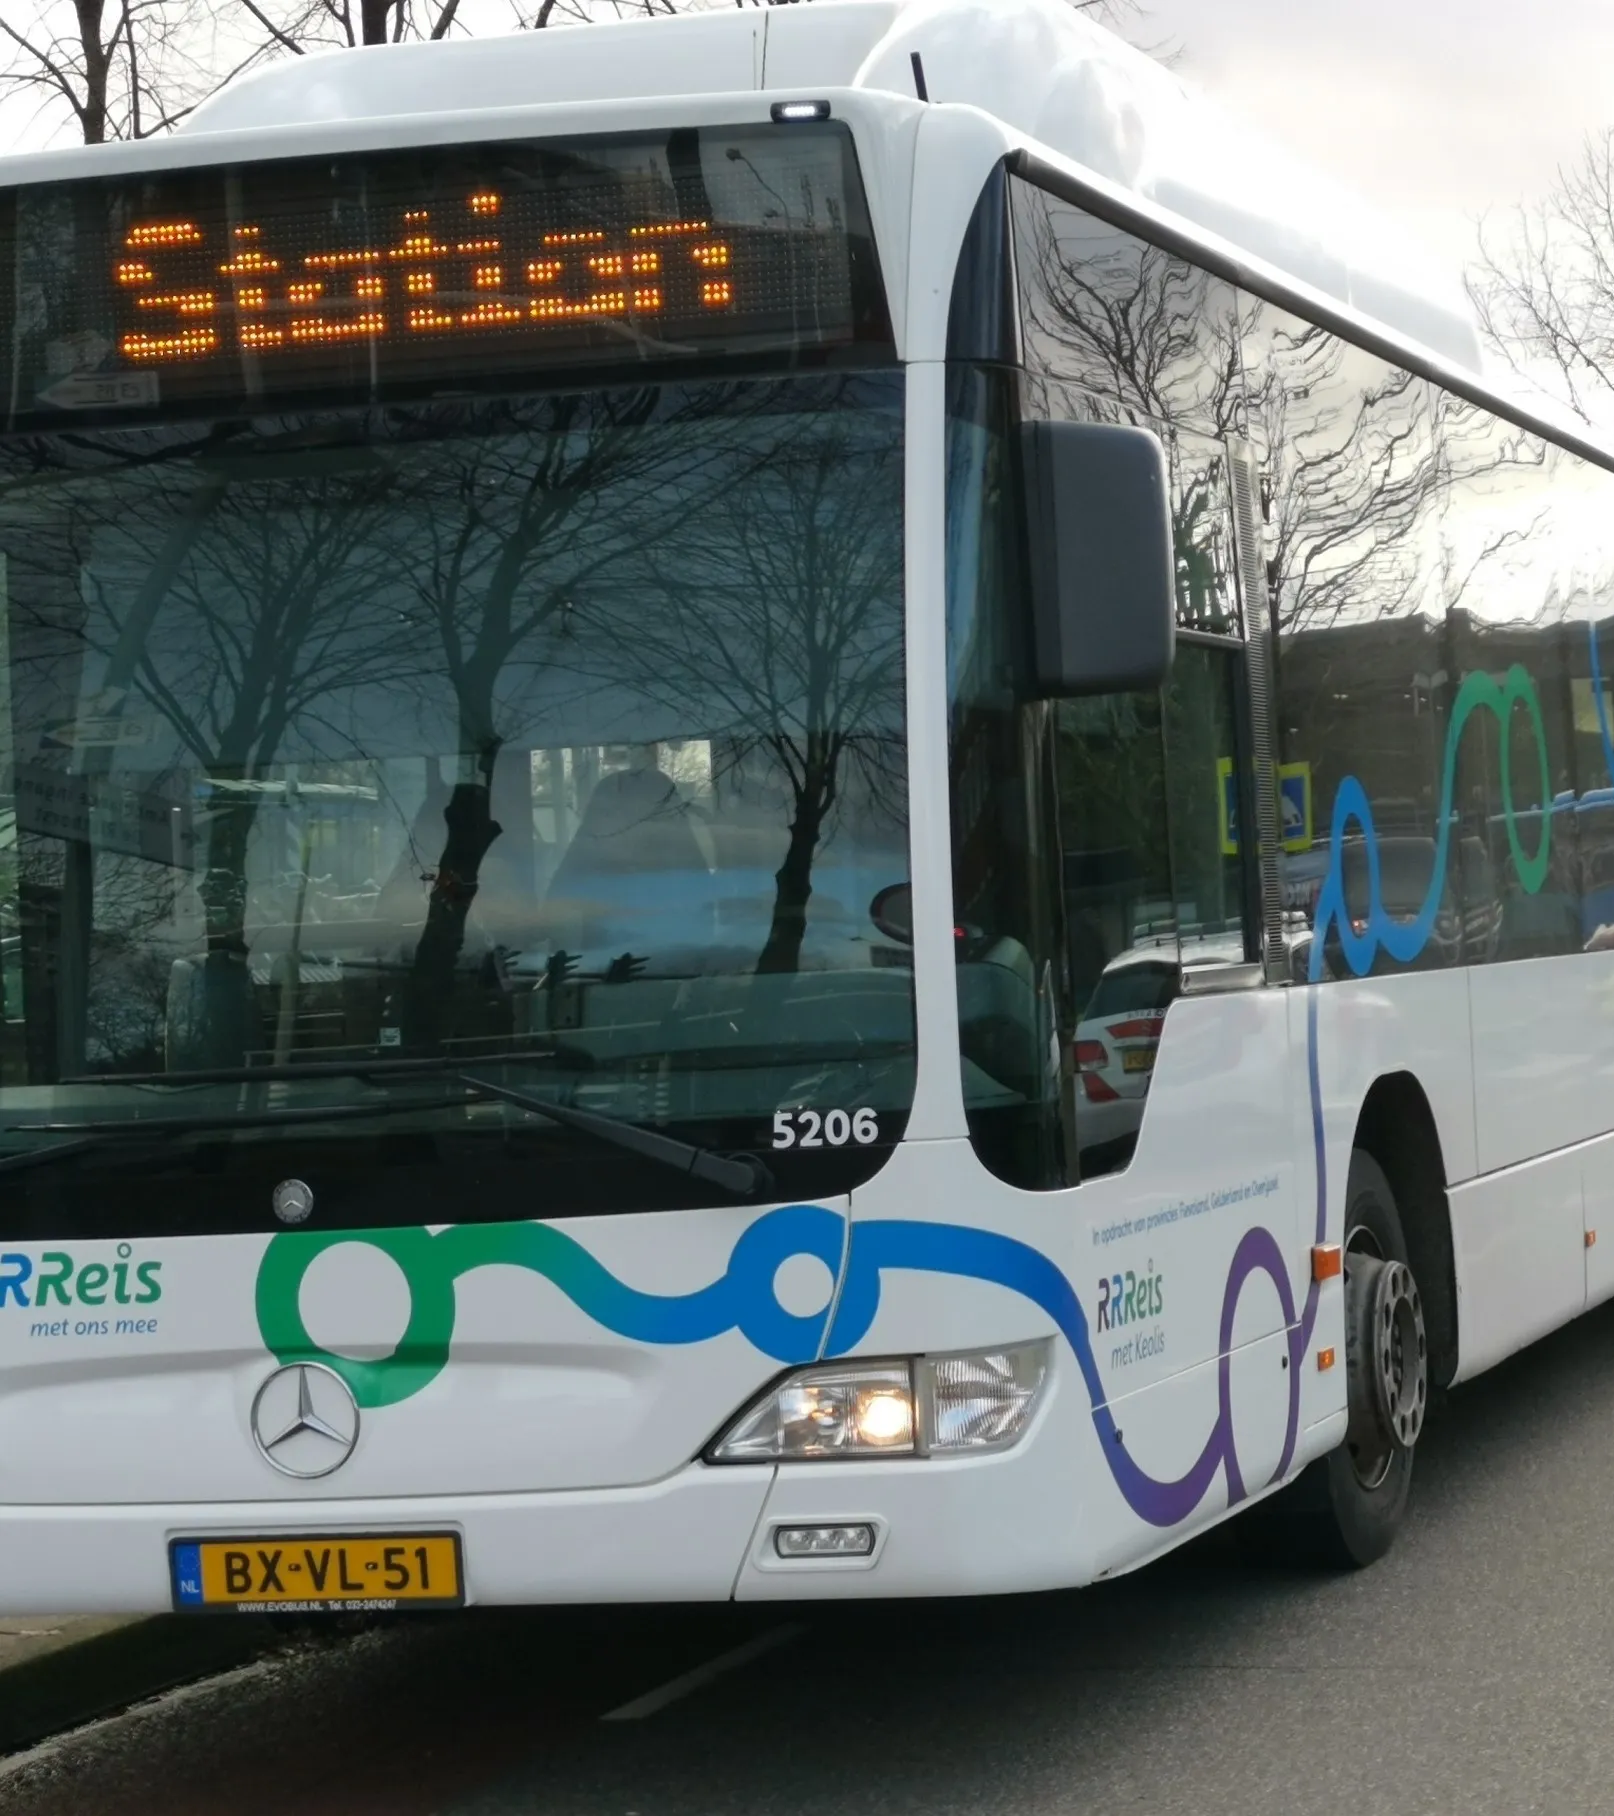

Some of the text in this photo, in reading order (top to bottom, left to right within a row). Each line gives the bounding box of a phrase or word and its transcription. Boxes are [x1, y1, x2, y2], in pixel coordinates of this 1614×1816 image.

[118, 196, 731, 358] Station
[772, 1107, 879, 1149] 5206
[1102, 1218, 1133, 1245] opdracht
[1097, 1258, 1163, 1334] RRReis
[30, 1319, 158, 1337] met ons mee
[1111, 1325, 1165, 1370] met Keolis
[181, 1579, 199, 1593] NL
[224, 1546, 430, 1595] BX-VL-51
